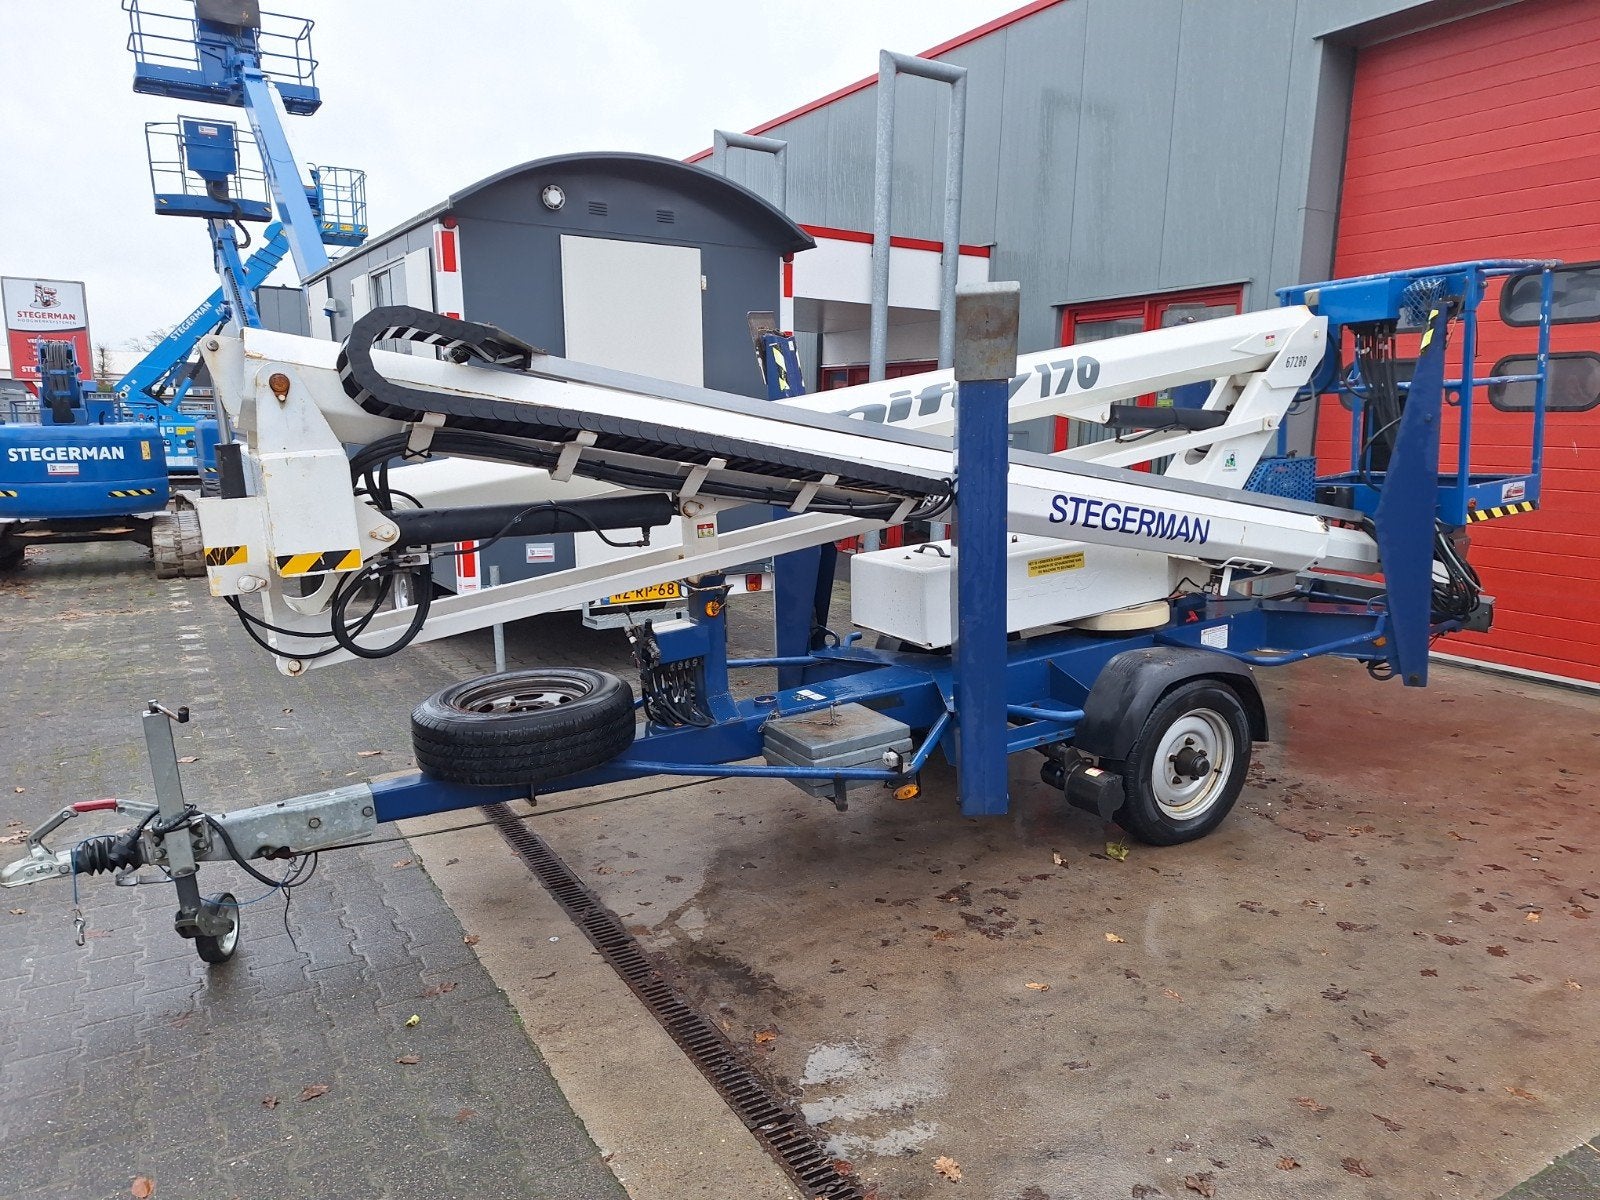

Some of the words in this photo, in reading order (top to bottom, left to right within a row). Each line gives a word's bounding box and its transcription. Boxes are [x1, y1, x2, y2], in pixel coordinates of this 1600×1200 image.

[17, 310, 76, 320] STEGERMAN
[170, 301, 212, 341] STEGERMAN
[1035, 355, 1100, 398] 170
[7, 446, 125, 462] STEGERMAN
[1049, 494, 1210, 544] STEGERMAN
